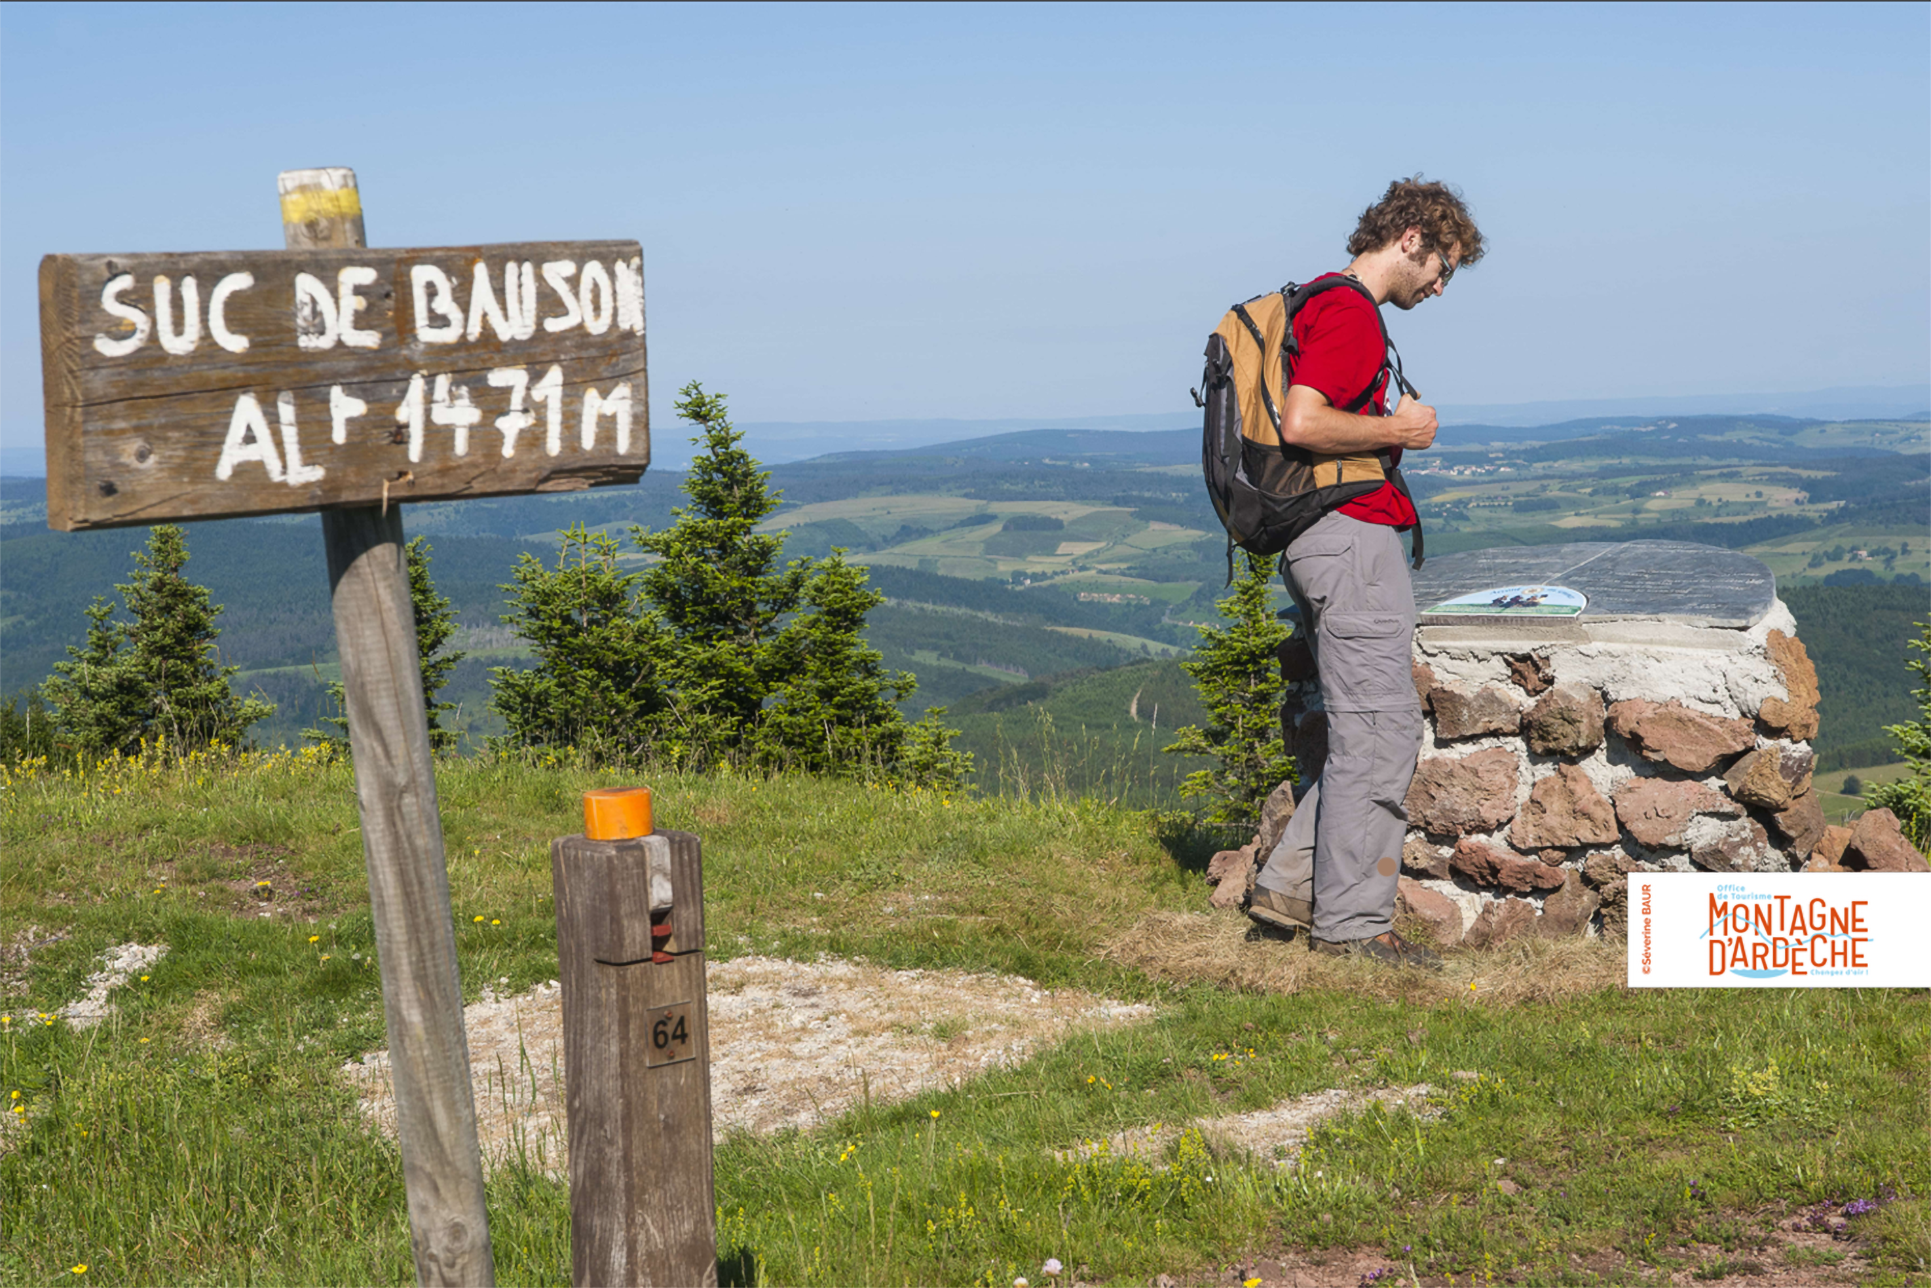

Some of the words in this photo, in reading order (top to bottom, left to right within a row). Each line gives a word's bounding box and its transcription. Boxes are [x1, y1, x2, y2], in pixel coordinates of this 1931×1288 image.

[93, 270, 255, 358] SUC
[295, 265, 382, 350] DE
[394, 363, 564, 463] 1471
[580, 381, 633, 456] M
[652, 1015, 689, 1049] 64
